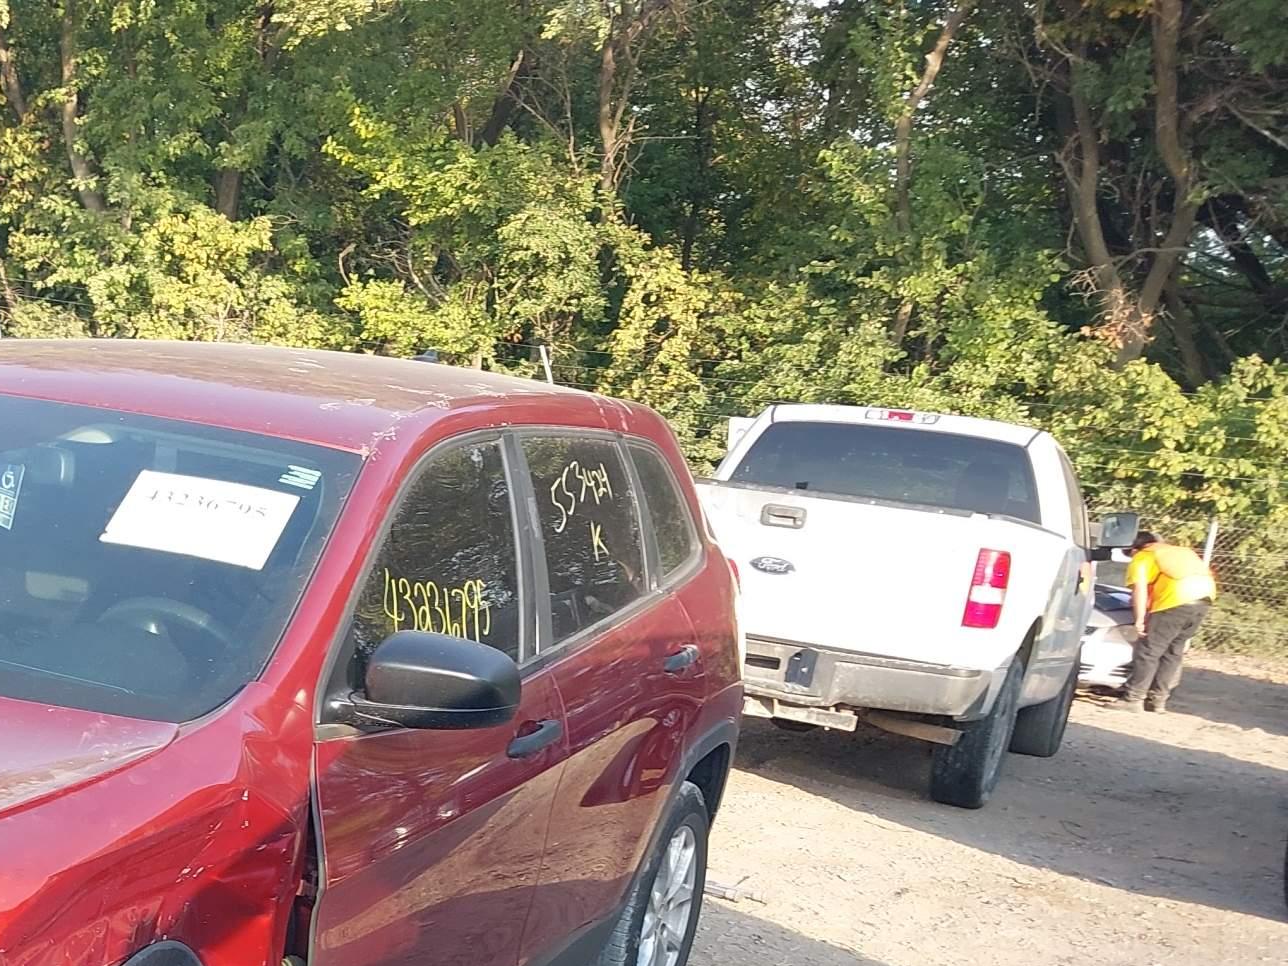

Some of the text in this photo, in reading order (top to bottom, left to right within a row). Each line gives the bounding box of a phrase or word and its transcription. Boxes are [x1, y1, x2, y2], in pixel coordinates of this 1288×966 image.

[550, 461, 613, 533] 553424
[590, 520, 610, 562] K
[383, 567, 491, 643] 43236795
